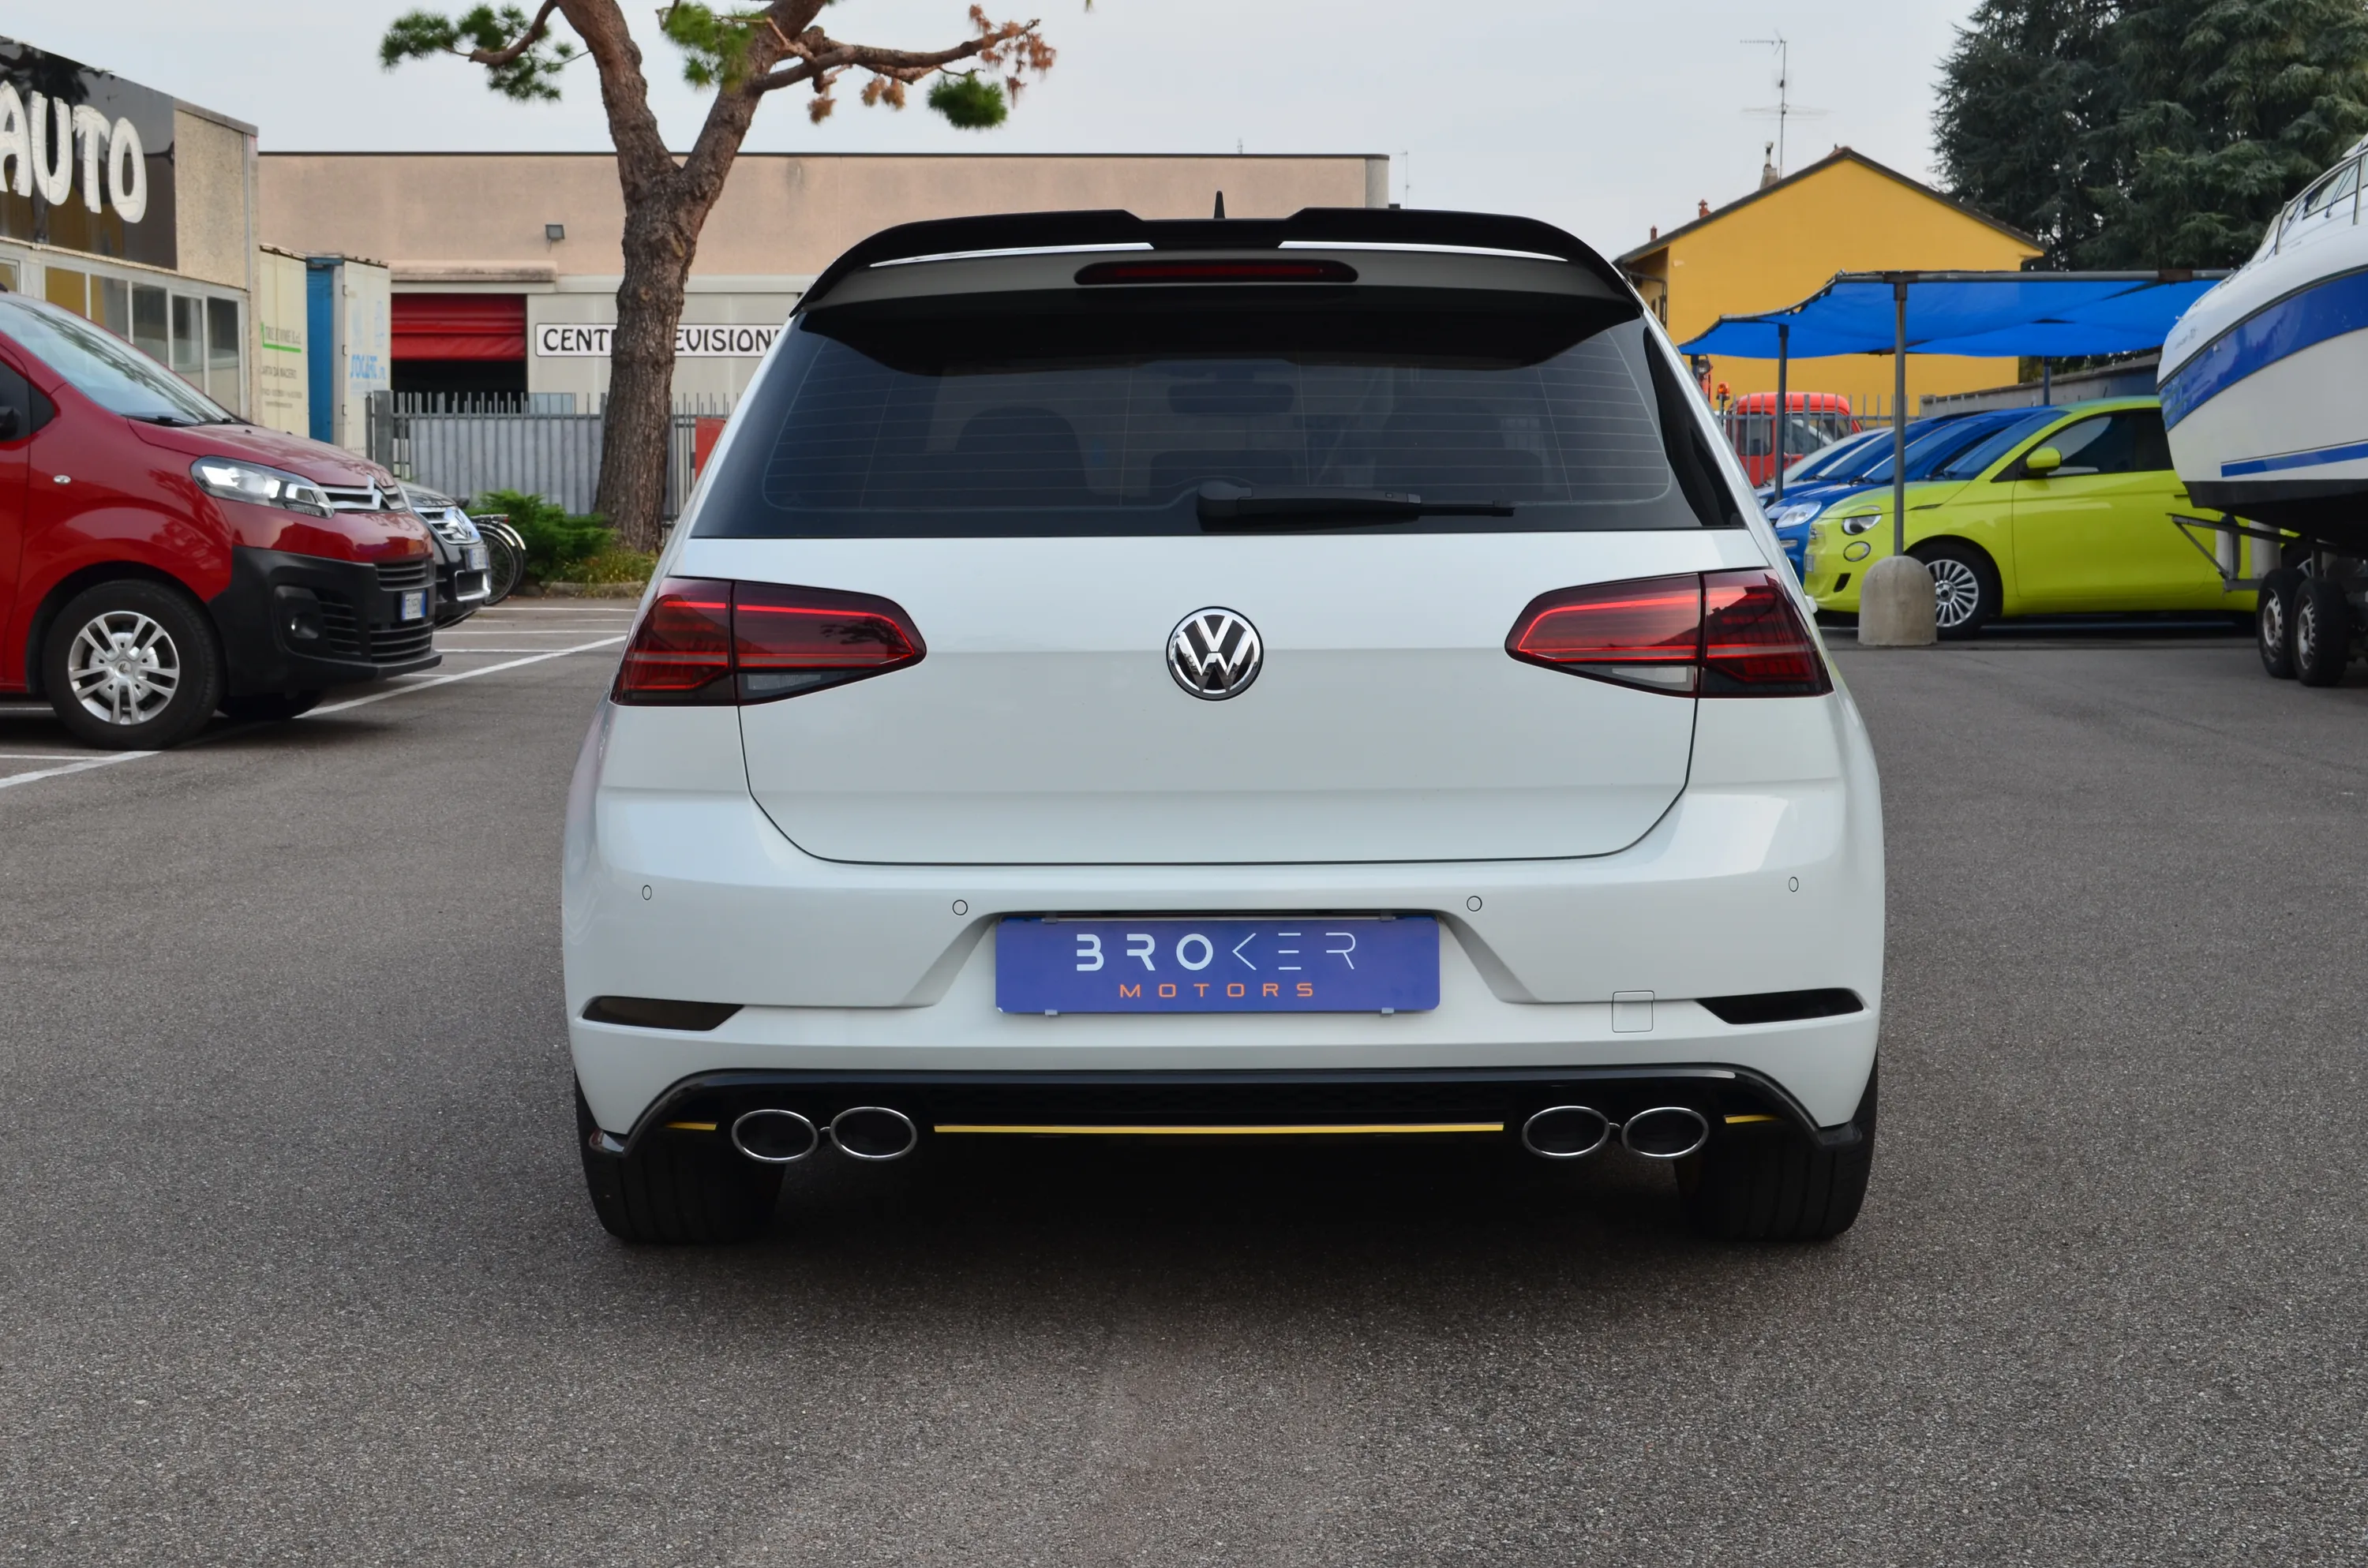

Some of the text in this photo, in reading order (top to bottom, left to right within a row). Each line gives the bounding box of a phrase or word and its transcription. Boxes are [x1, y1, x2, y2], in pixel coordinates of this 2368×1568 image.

[0, 80, 148, 223] AUTO
[542, 328, 780, 354] CENT EVISION
[1076, 933, 1357, 971] BROKER
[1119, 982, 1314, 999] MOTORS
